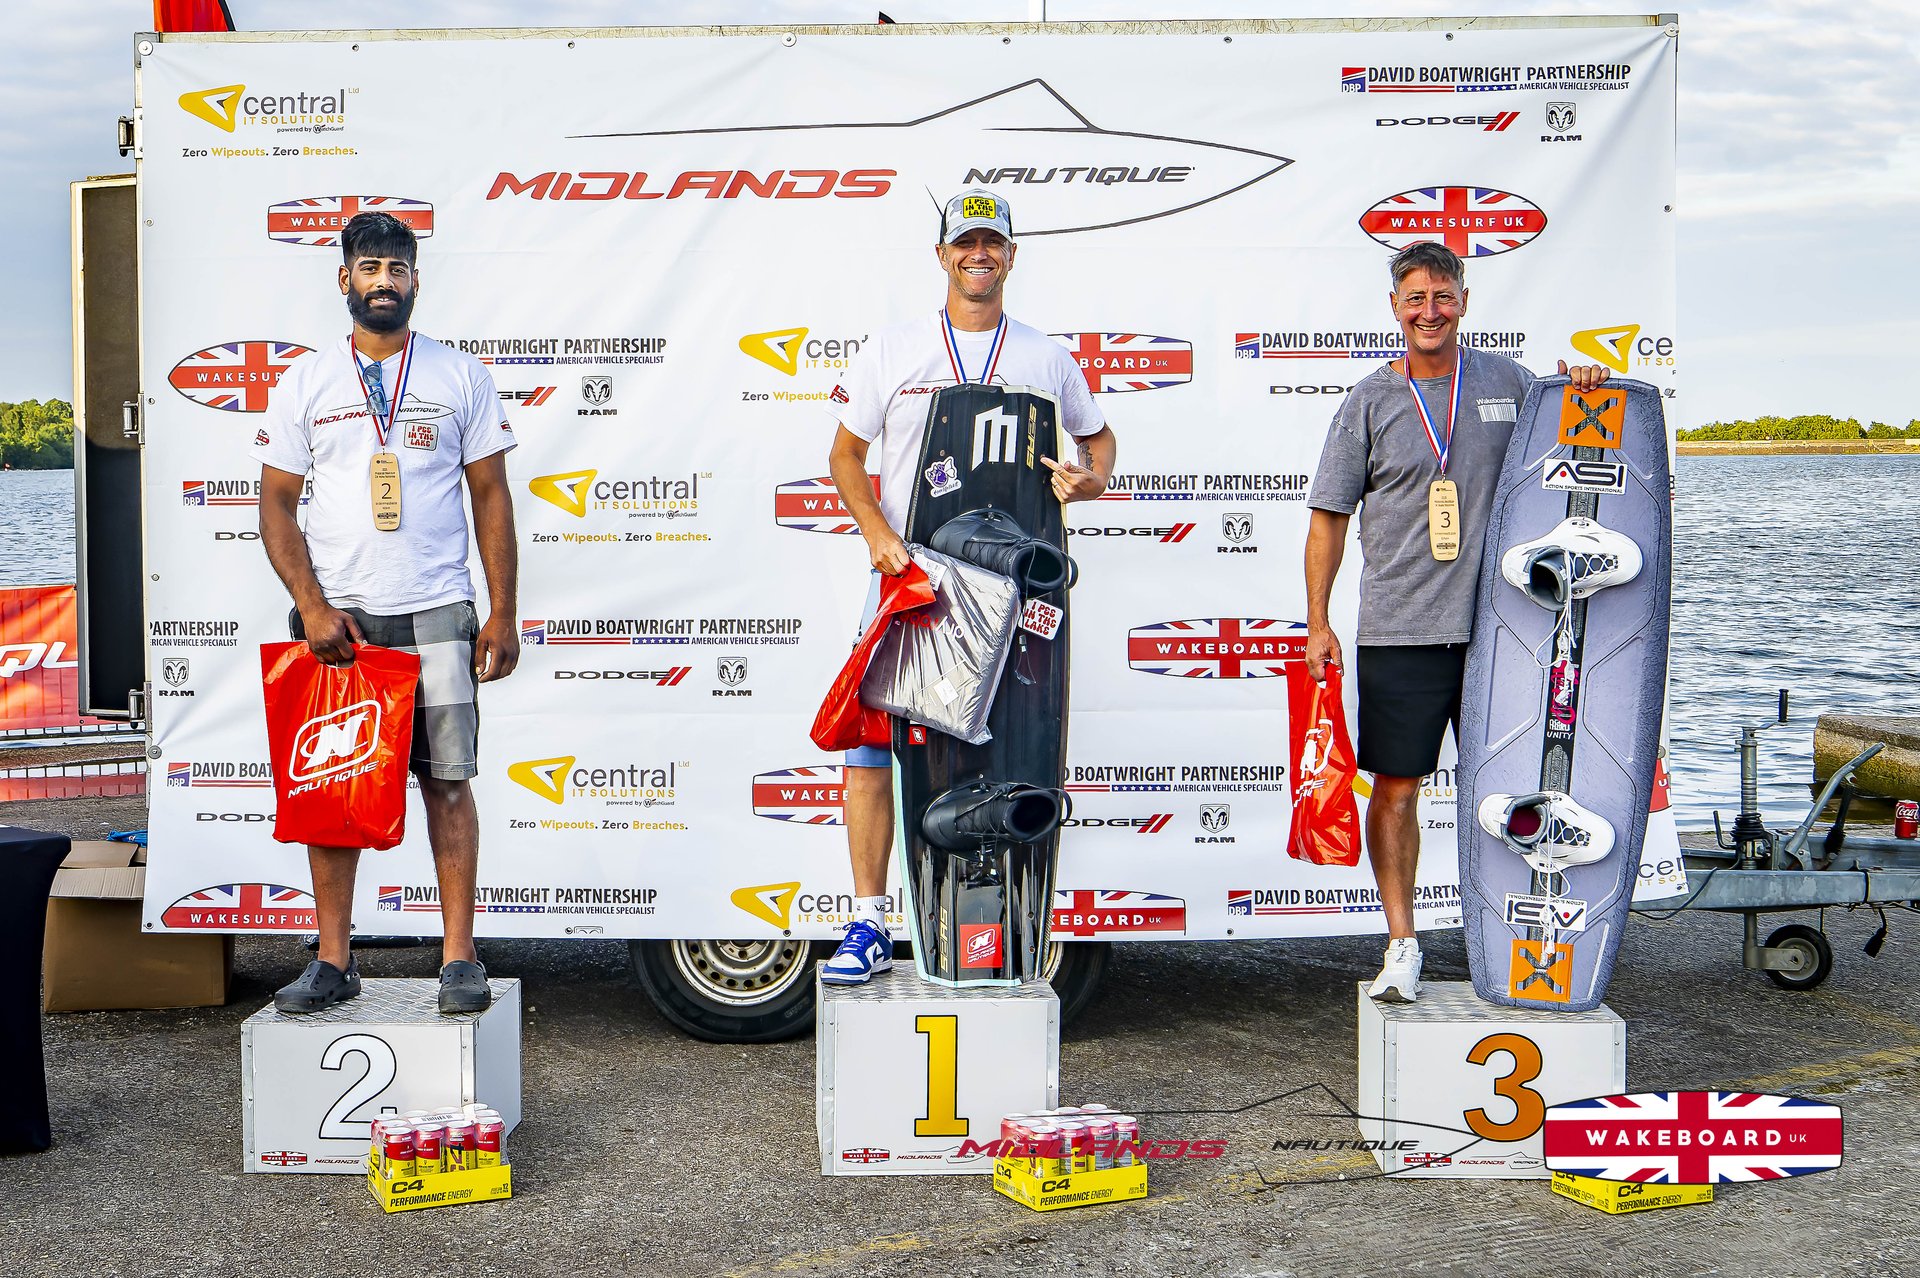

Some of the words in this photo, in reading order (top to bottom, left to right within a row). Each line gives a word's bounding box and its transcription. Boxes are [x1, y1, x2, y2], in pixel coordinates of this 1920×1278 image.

[1369, 67, 1414, 82] DAVID
[1420, 67, 1521, 82] BOATWRIGHT
[1527, 64, 1631, 81] PARTNERSHIP
[1342, 83, 1362, 93] DBP
[1519, 82, 1557, 91] AMERICAN
[1559, 82, 1588, 91] VEHICLE
[1589, 82, 1629, 91] SPECIALIST
[243, 88, 345, 116] central
[243, 116, 255, 125] IT
[261, 115, 344, 125] SOLUTIONS
[1376, 116, 1498, 127] DODGE
[276, 126, 304, 134] powered
[304, 125, 313, 133] by
[1541, 134, 1582, 142] RAM
[182, 148, 208, 157] Zero
[211, 146, 269, 158] Wipeouts.
[273, 147, 300, 156] Zero
[303, 146, 358, 156] Breaches.
[485, 169, 897, 200] MIDLANDS
[962, 166, 1191, 185] NAUTIQUE
[1391, 217, 1496, 228] WAKESURF
[1504, 216, 1524, 227] UK
[460, 338, 558, 354] BOATWRIGHT
[564, 338, 666, 354] PARTNERSHIP
[1262, 333, 1308, 348] DAVID
[556, 356, 593, 364] AMERICAN
[594, 356, 624, 364] VEHICLE
[625, 356, 664, 364] SPECIALIST
[1236, 350, 1255, 359] DBP
[806, 360, 820, 368] IT
[1638, 358, 1650, 366] IT
[742, 392, 769, 401] Zero
[772, 391, 828, 403] Wipeouts
[410, 439, 430, 447] LAKE
[1546, 462, 1624, 487] ASI
[594, 473, 698, 500] central
[1204, 474, 1308, 490] PARTNERSHIP
[207, 481, 250, 496] DAVID
[382, 482, 392, 500] 2
[1584, 486, 1622, 494] INTERNATIONAL
[184, 497, 200, 506] DBP
[1266, 492, 1306, 500] SPECIALIST
[594, 502, 606, 510] IT
[612, 500, 698, 510] SOLUTIONS
[1440, 512, 1450, 528] 3
[532, 533, 559, 543] Zero
[562, 532, 622, 544] Wipeouts.
[626, 532, 652, 542] Zero
[656, 532, 712, 542] Breaches.
[1032, 602, 1036, 610] I
[1038, 604, 1056, 618] PEE
[1024, 608, 1036, 620] IN
[1038, 614, 1056, 628] THE
[547, 620, 591, 634] DAVID
[596, 620, 694, 634] BOATWRIGHT
[700, 619, 802, 634] PARTNERSHIP
[1025, 619, 1050, 635] LAKE
[522, 636, 540, 645] DBP
[691, 637, 728, 645] AMERICAN
[730, 637, 758, 645] VEHICLE
[760, 637, 800, 645] SPECIALIST
[1156, 643, 1290, 654] WAKEBOARD
[554, 671, 671, 680] DODGE
[1547, 731, 1574, 740] UNITY
[192, 763, 236, 777] DAVID
[572, 762, 674, 788] central
[1074, 766, 1175, 782] BOATWRIGHT
[1181, 766, 1284, 781] PARTNERSHIP
[168, 778, 186, 787] DBP
[288, 761, 380, 799] NAUTIQUE
[572, 789, 584, 797] IT
[590, 788, 674, 797] SOLUTIONS
[1173, 784, 1211, 792] AMERICAN
[1212, 784, 1242, 792] VEHICLE
[1243, 784, 1282, 792] SPECIALIST
[510, 820, 536, 830] Zero
[540, 820, 598, 830] Wipeouts.
[602, 820, 628, 830] Zero
[632, 820, 688, 830] Breaches.
[1428, 820, 1454, 829] Zero
[555, 888, 658, 904] PARTNERSHIP
[1255, 890, 1300, 905] DAVID
[378, 902, 397, 911] DBP
[547, 906, 584, 914] AMERICAN
[586, 906, 614, 914] VEHICLE
[616, 906, 655, 914] SPECIALIST
[1228, 906, 1248, 915] DBP
[190, 914, 287, 924] WAKESURF
[294, 915, 313, 924] UK
[798, 915, 811, 923] IT
[914, 1014, 969, 1137] 1
[319, 1033, 397, 1140] 2
[1463, 1032, 1546, 1142] 3
[392, 1180, 424, 1194] C4
[1042, 1178, 1070, 1193] C4
[1618, 1184, 1644, 1198] C4
[390, 1192, 446, 1207] PERFORMANCE
[448, 1189, 473, 1200] ENERGY
[1040, 1192, 1090, 1206] PERFORMANCE
[1090, 1188, 1114, 1200] ENERGY
[1616, 1197, 1661, 1212] PERFORMANCE
